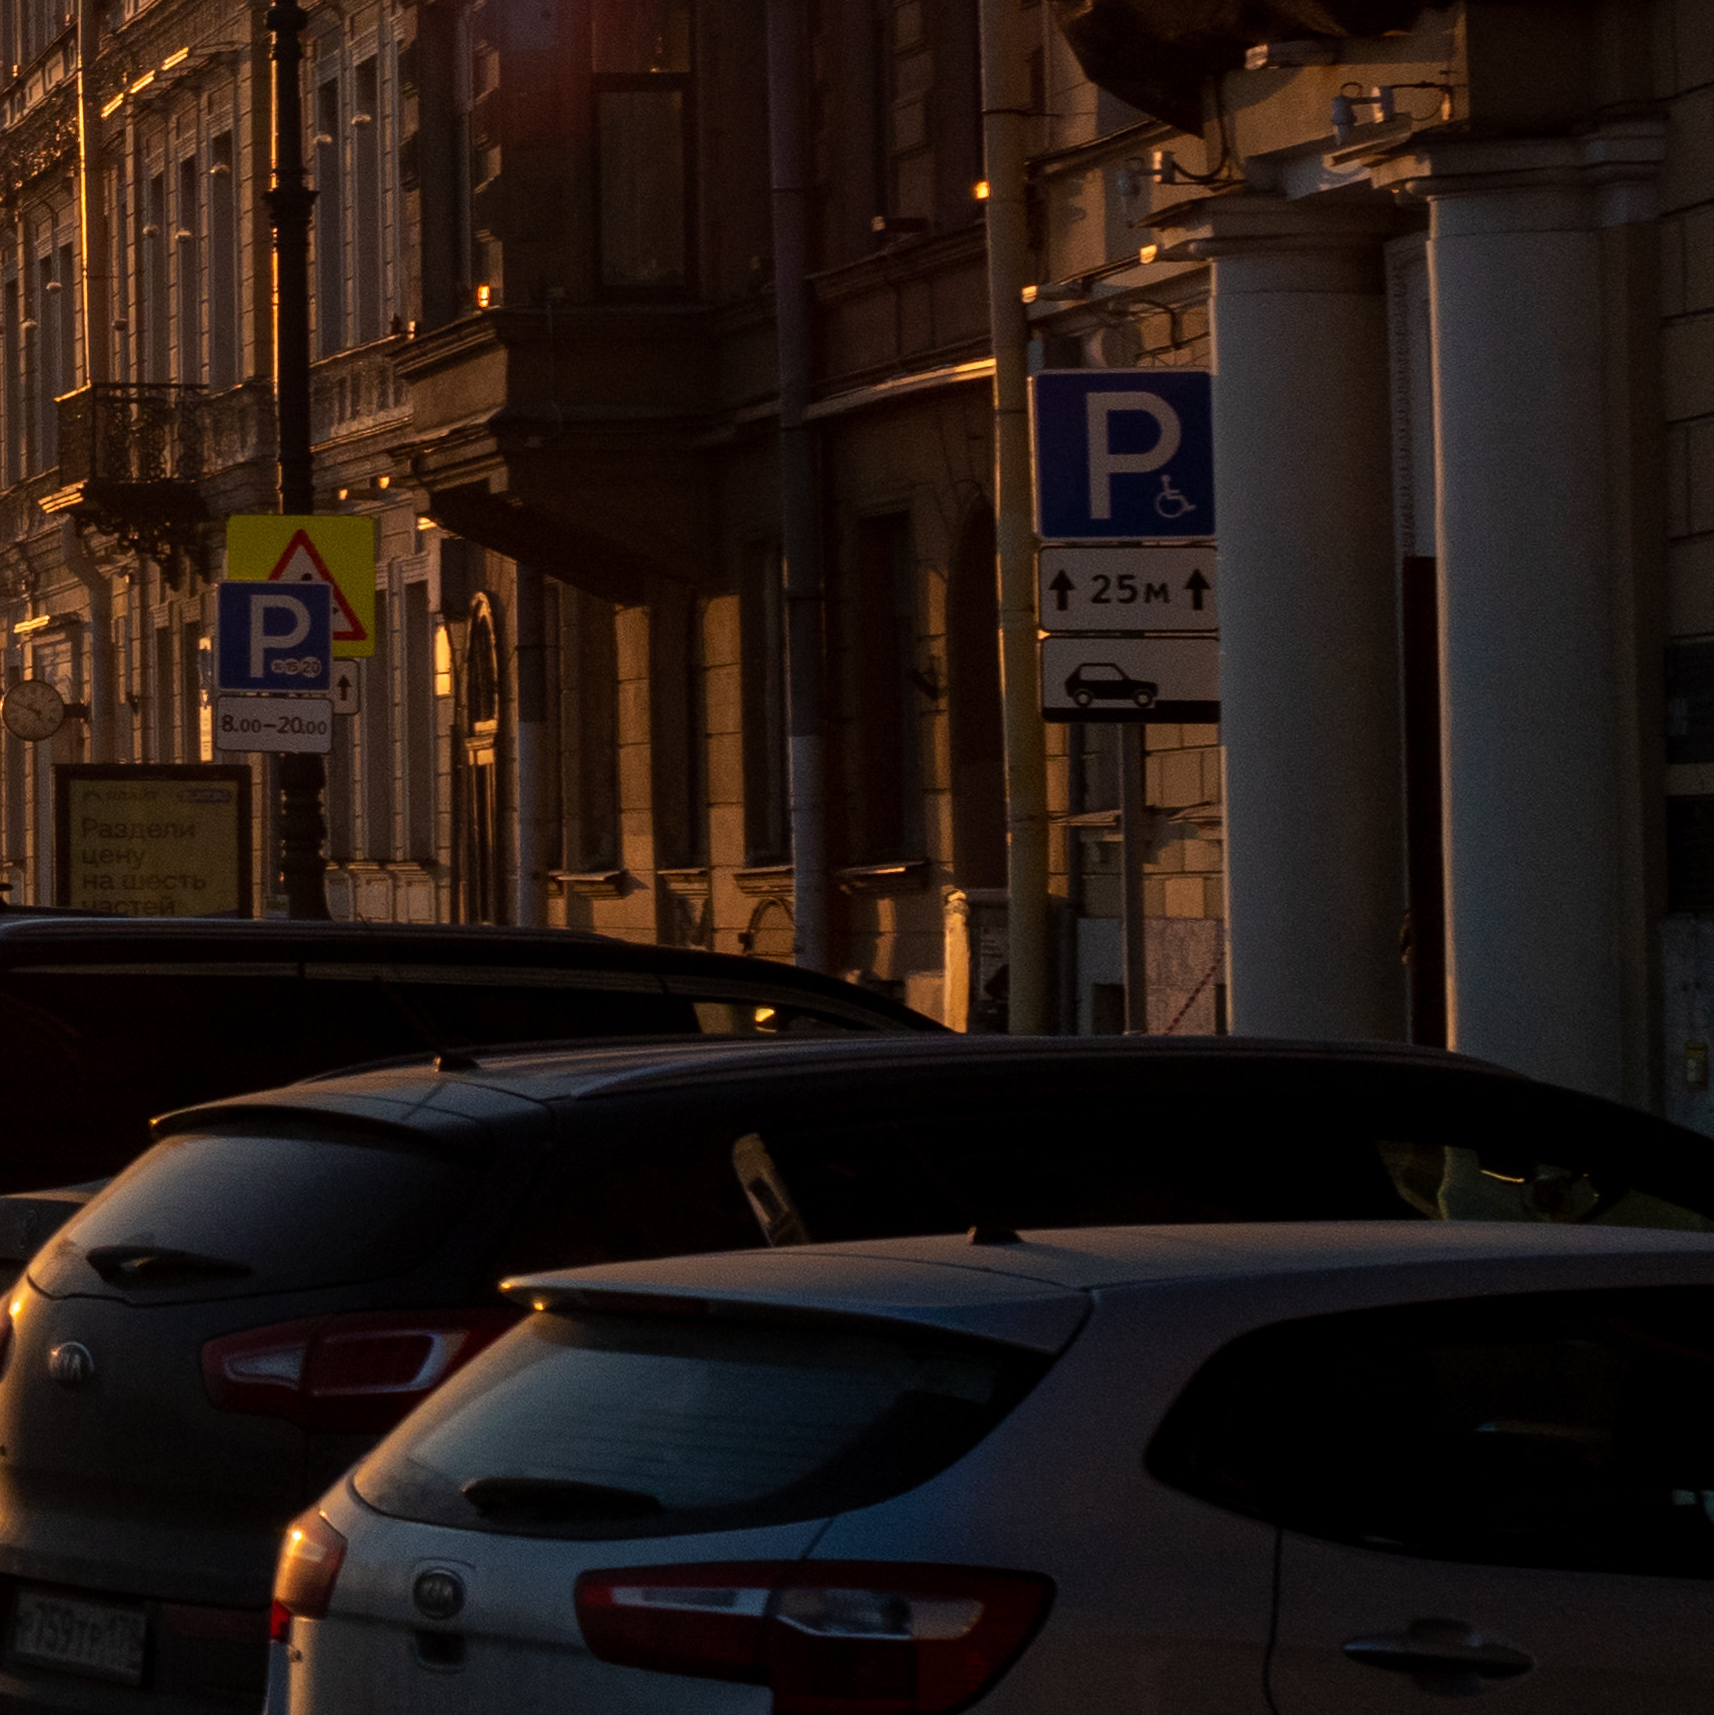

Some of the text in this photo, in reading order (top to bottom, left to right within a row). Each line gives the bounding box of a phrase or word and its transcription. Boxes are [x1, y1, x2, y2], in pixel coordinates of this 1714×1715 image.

[1086, 391, 1181, 520] P
[250, 594, 312, 679] P
[302, 660, 321, 674] 20
[81, 817, 196, 841] Раздели
[81, 849, 146, 870] цену
[83, 874, 207, 891] на шесть
